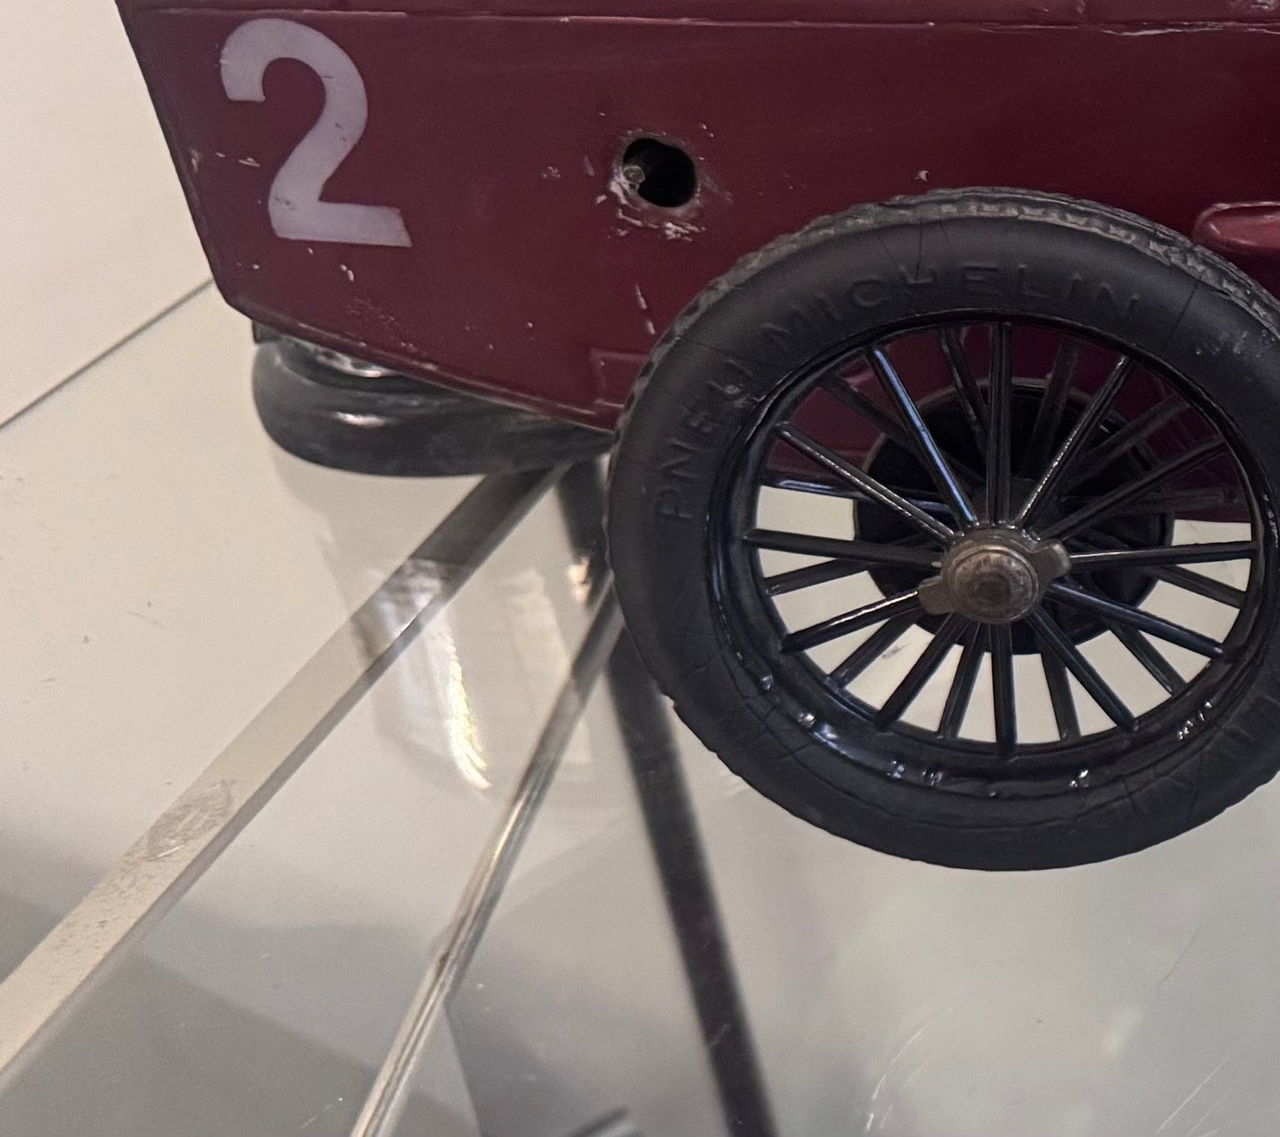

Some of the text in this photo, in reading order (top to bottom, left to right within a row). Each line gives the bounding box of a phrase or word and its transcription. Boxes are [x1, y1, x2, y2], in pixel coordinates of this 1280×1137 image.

[220, 18, 413, 248] 2
[655, 262, 1142, 523] PNEU MICHELIN
